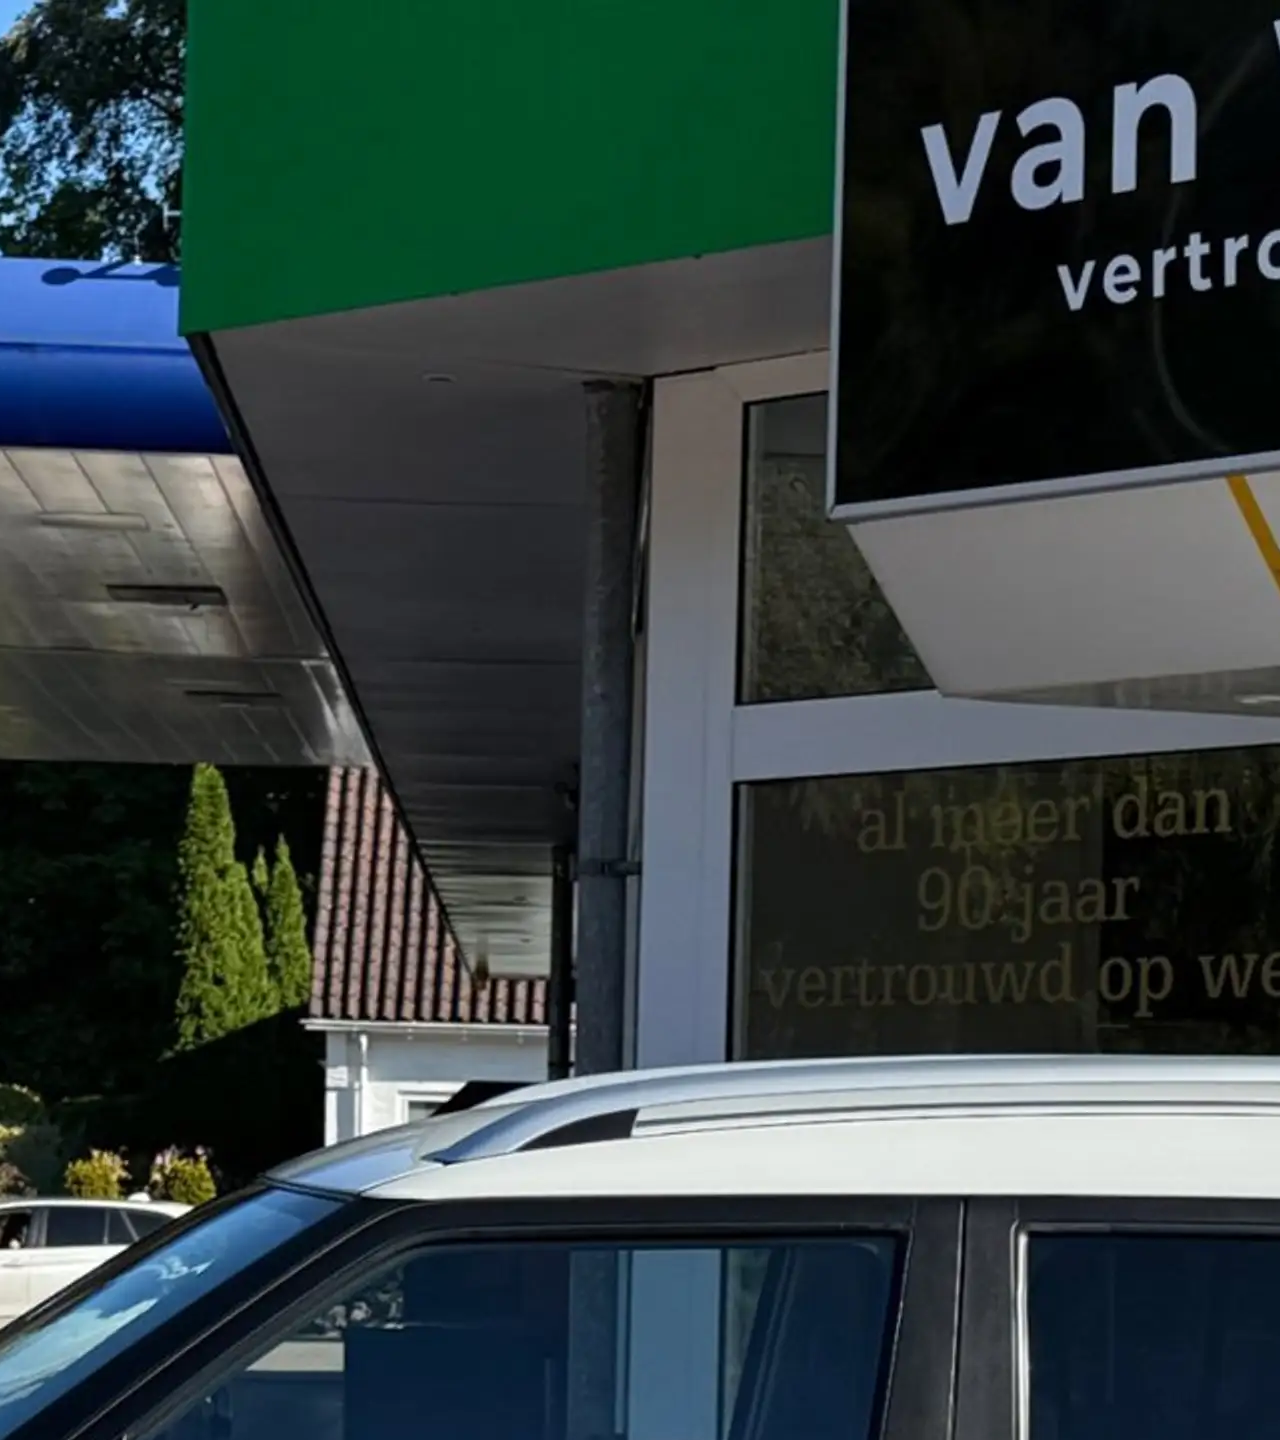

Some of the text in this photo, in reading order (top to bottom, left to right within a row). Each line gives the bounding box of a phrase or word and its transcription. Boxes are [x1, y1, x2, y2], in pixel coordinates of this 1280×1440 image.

[921, 73, 1197, 226] van
[930, 796, 1091, 849] meer
[1113, 775, 1233, 840] dan
[917, 863, 1141, 944] 90 jaar
[760, 941, 1078, 1010] vertrouwd
[1099, 954, 1174, 1019] op
